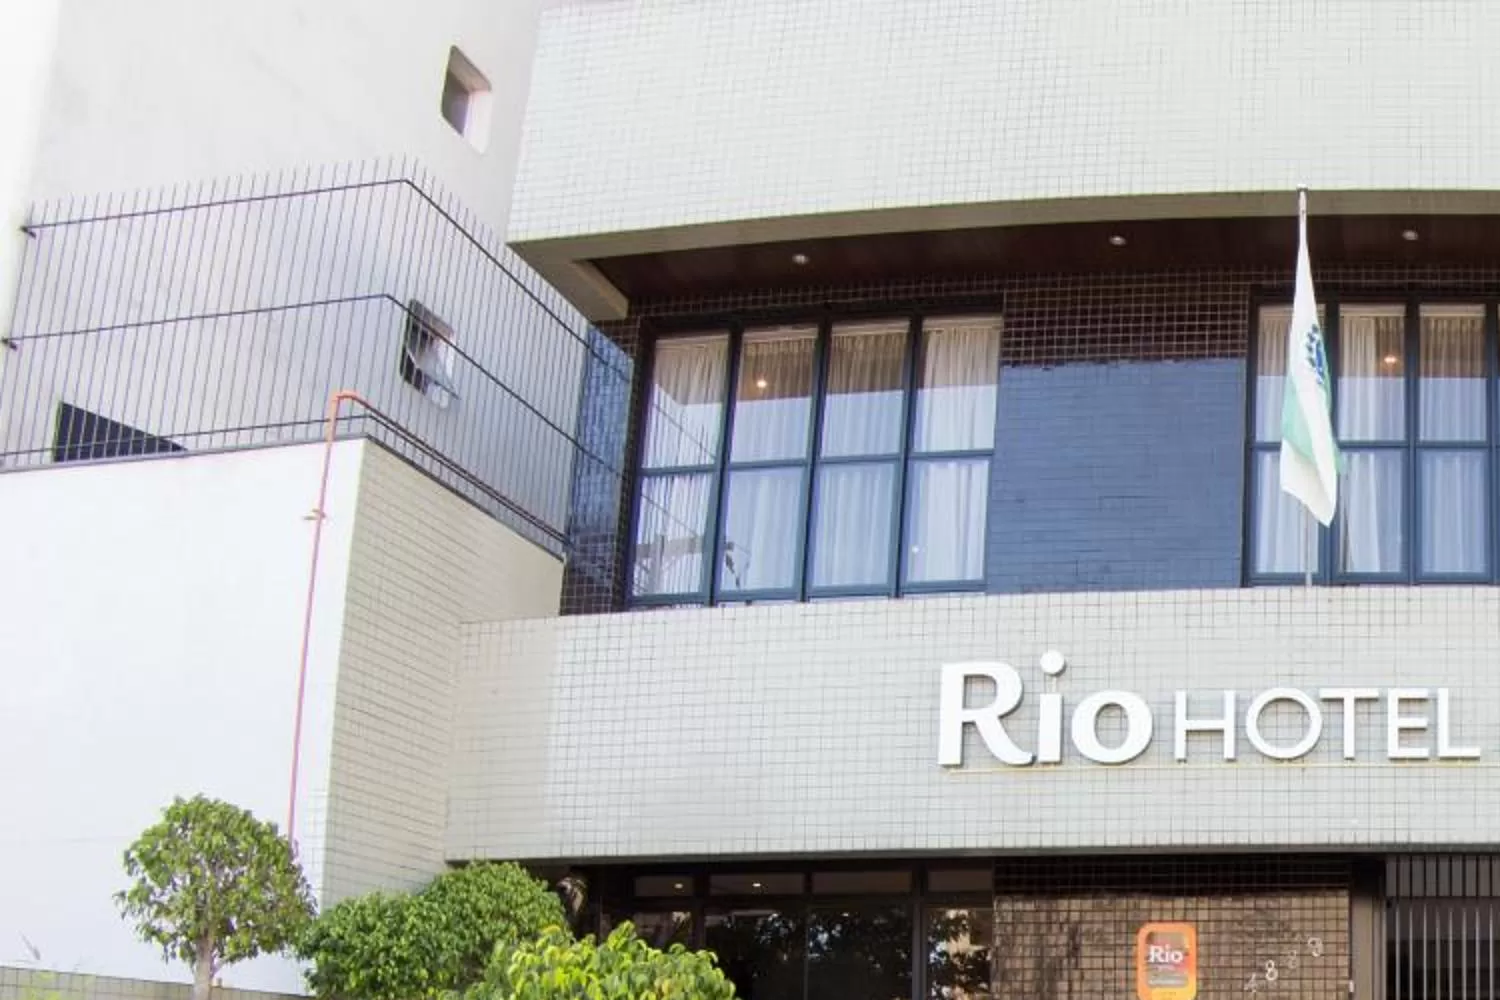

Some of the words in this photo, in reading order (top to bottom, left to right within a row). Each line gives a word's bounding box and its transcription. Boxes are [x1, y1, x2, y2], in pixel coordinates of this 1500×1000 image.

[937, 649, 1154, 766] Rio
[1173, 687, 1481, 761] HOTEL
[1148, 944, 1184, 963] Rio
